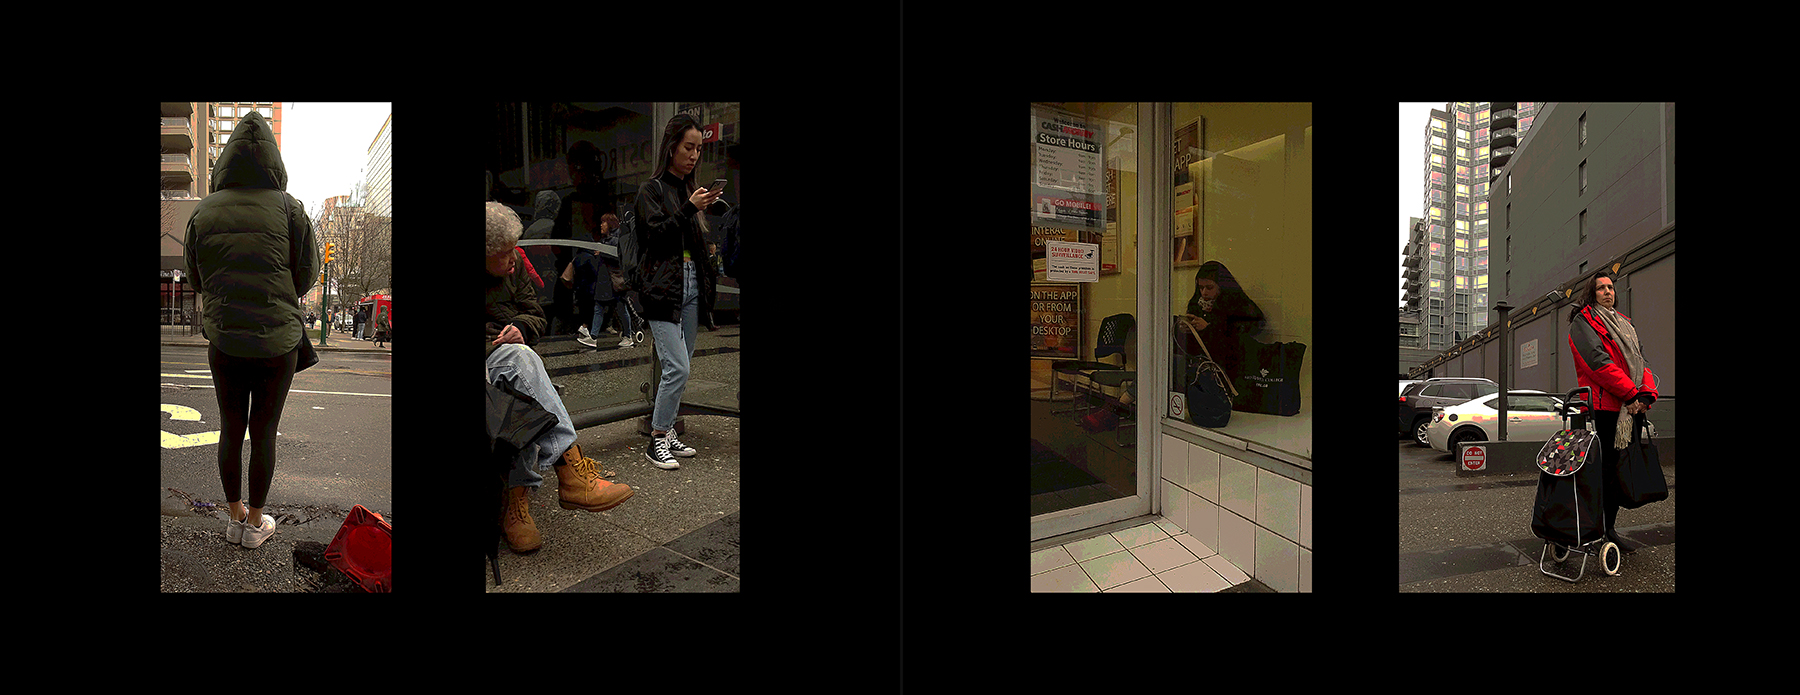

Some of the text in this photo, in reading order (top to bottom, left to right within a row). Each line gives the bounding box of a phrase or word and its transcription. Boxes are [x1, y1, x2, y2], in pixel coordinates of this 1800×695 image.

[1039, 133, 1096, 152] Store Hours
[1173, 153, 1192, 171] APP
[1055, 199, 1065, 207] GO
[1031, 226, 1067, 235] INTERAC
[1042, 291, 1059, 300] THE
[1060, 291, 1078, 300] APP
[1032, 302, 1072, 312] OR FROM
[1039, 314, 1064, 324] YOUR
[1032, 325, 1072, 336] DESKTOP
